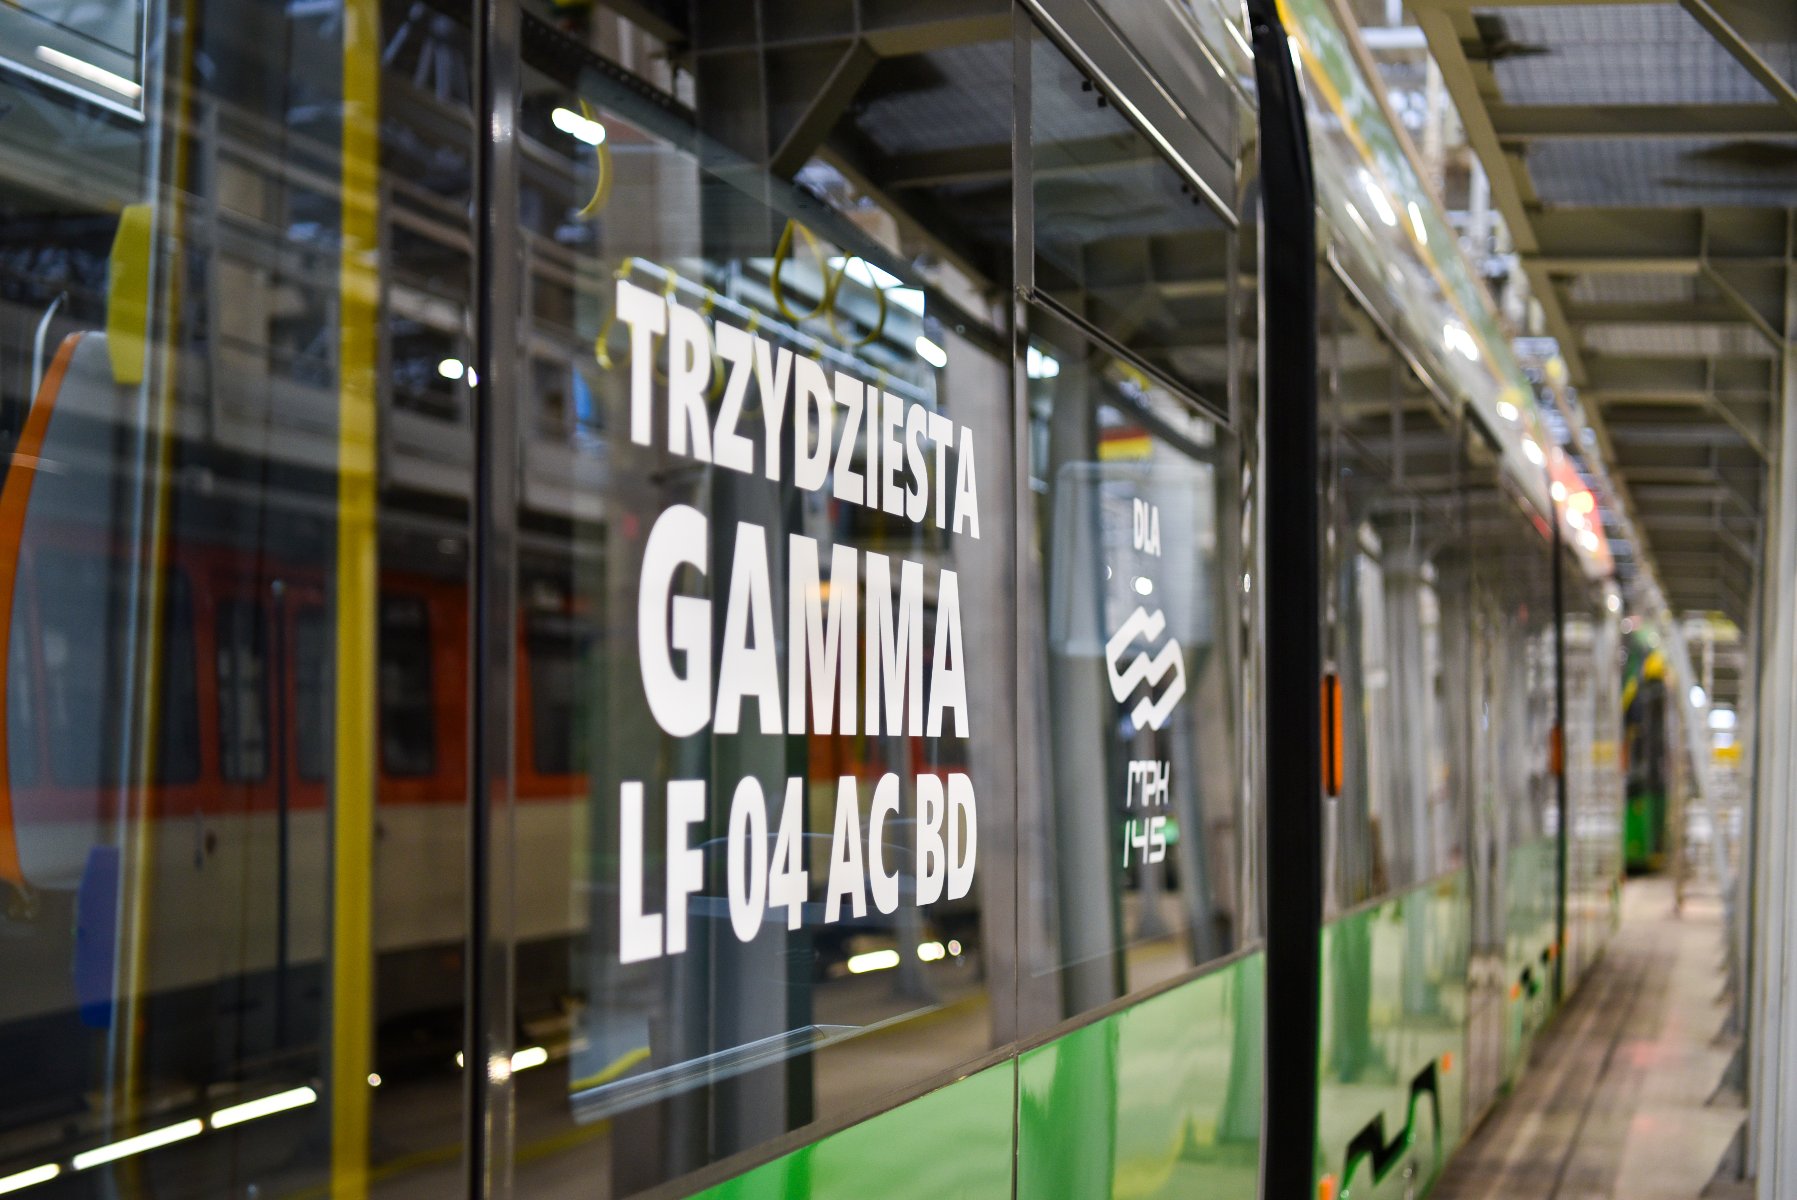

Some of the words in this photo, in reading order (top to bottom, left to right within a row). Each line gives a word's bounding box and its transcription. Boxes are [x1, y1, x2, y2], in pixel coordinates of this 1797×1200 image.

[617, 280, 980, 540] TRZYDZIESTA
[638, 504, 970, 738] GAMMA
[1133, 497, 1161, 557] DLA
[619, 779, 706, 964] LF
[727, 775, 808, 943] 04
[824, 773, 900, 924] AC
[916, 772, 978, 907] BD
[1123, 816, 1166, 868] 145
